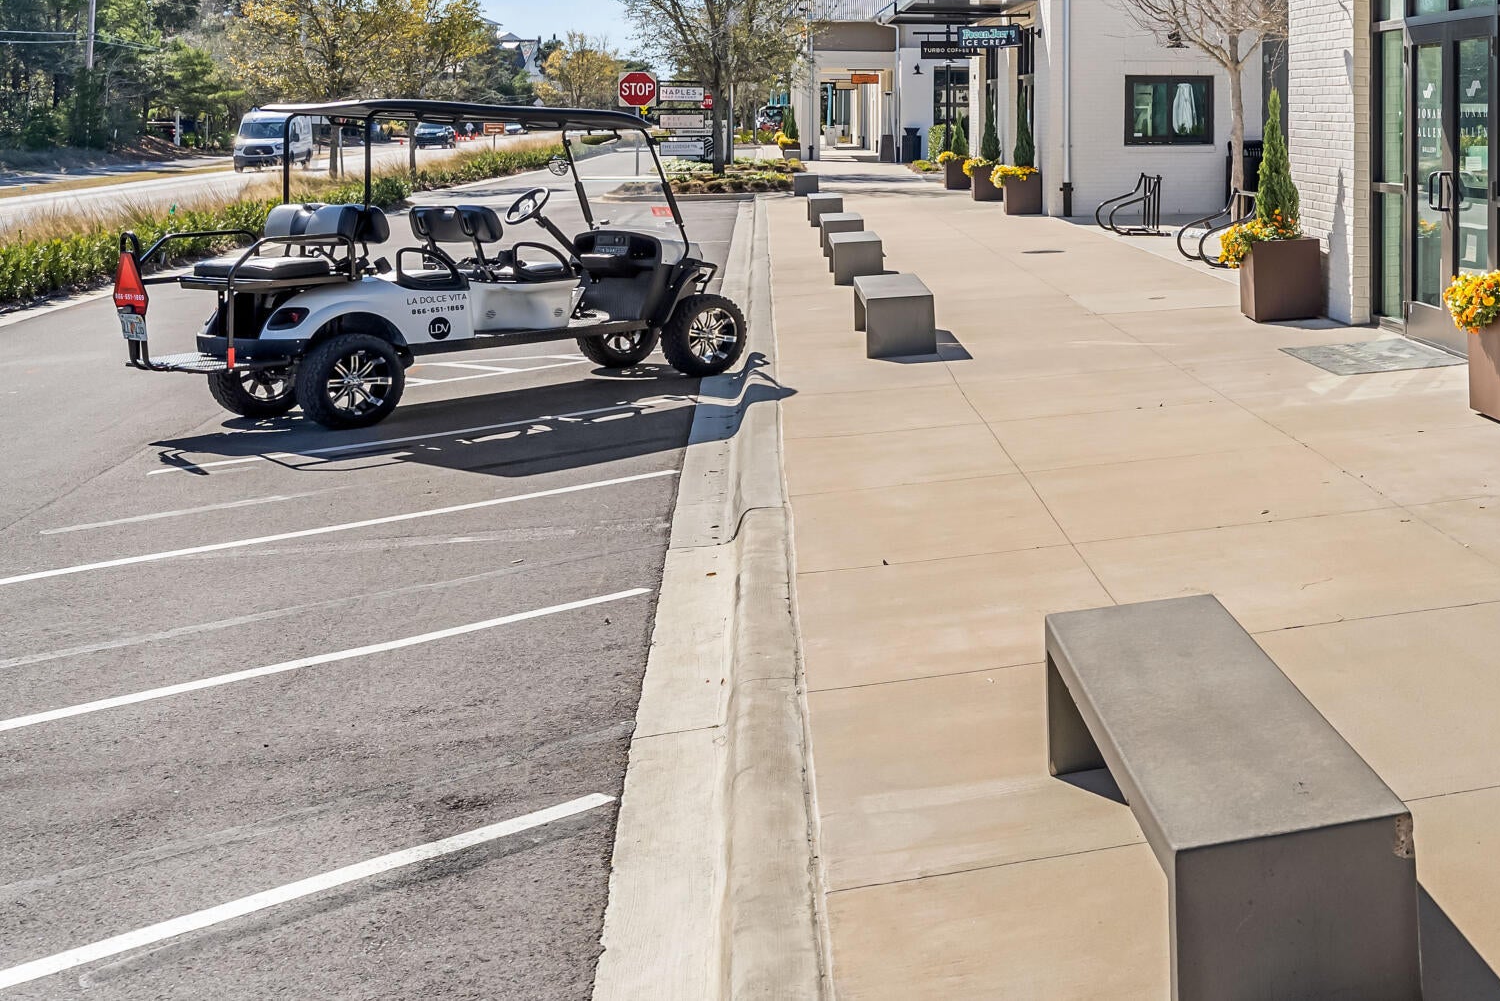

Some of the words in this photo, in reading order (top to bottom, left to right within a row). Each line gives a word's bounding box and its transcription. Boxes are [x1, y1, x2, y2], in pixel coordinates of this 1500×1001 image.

[962, 29, 989, 39] Pecan
[982, 38, 1014, 46] CREA
[621, 82, 654, 96] STOP
[1417, 127, 1442, 138] ALLEN
[420, 295, 447, 304] DOLCE
[411, 305, 465, 315] 866-651-1869
[430, 323, 450, 334] LDV
